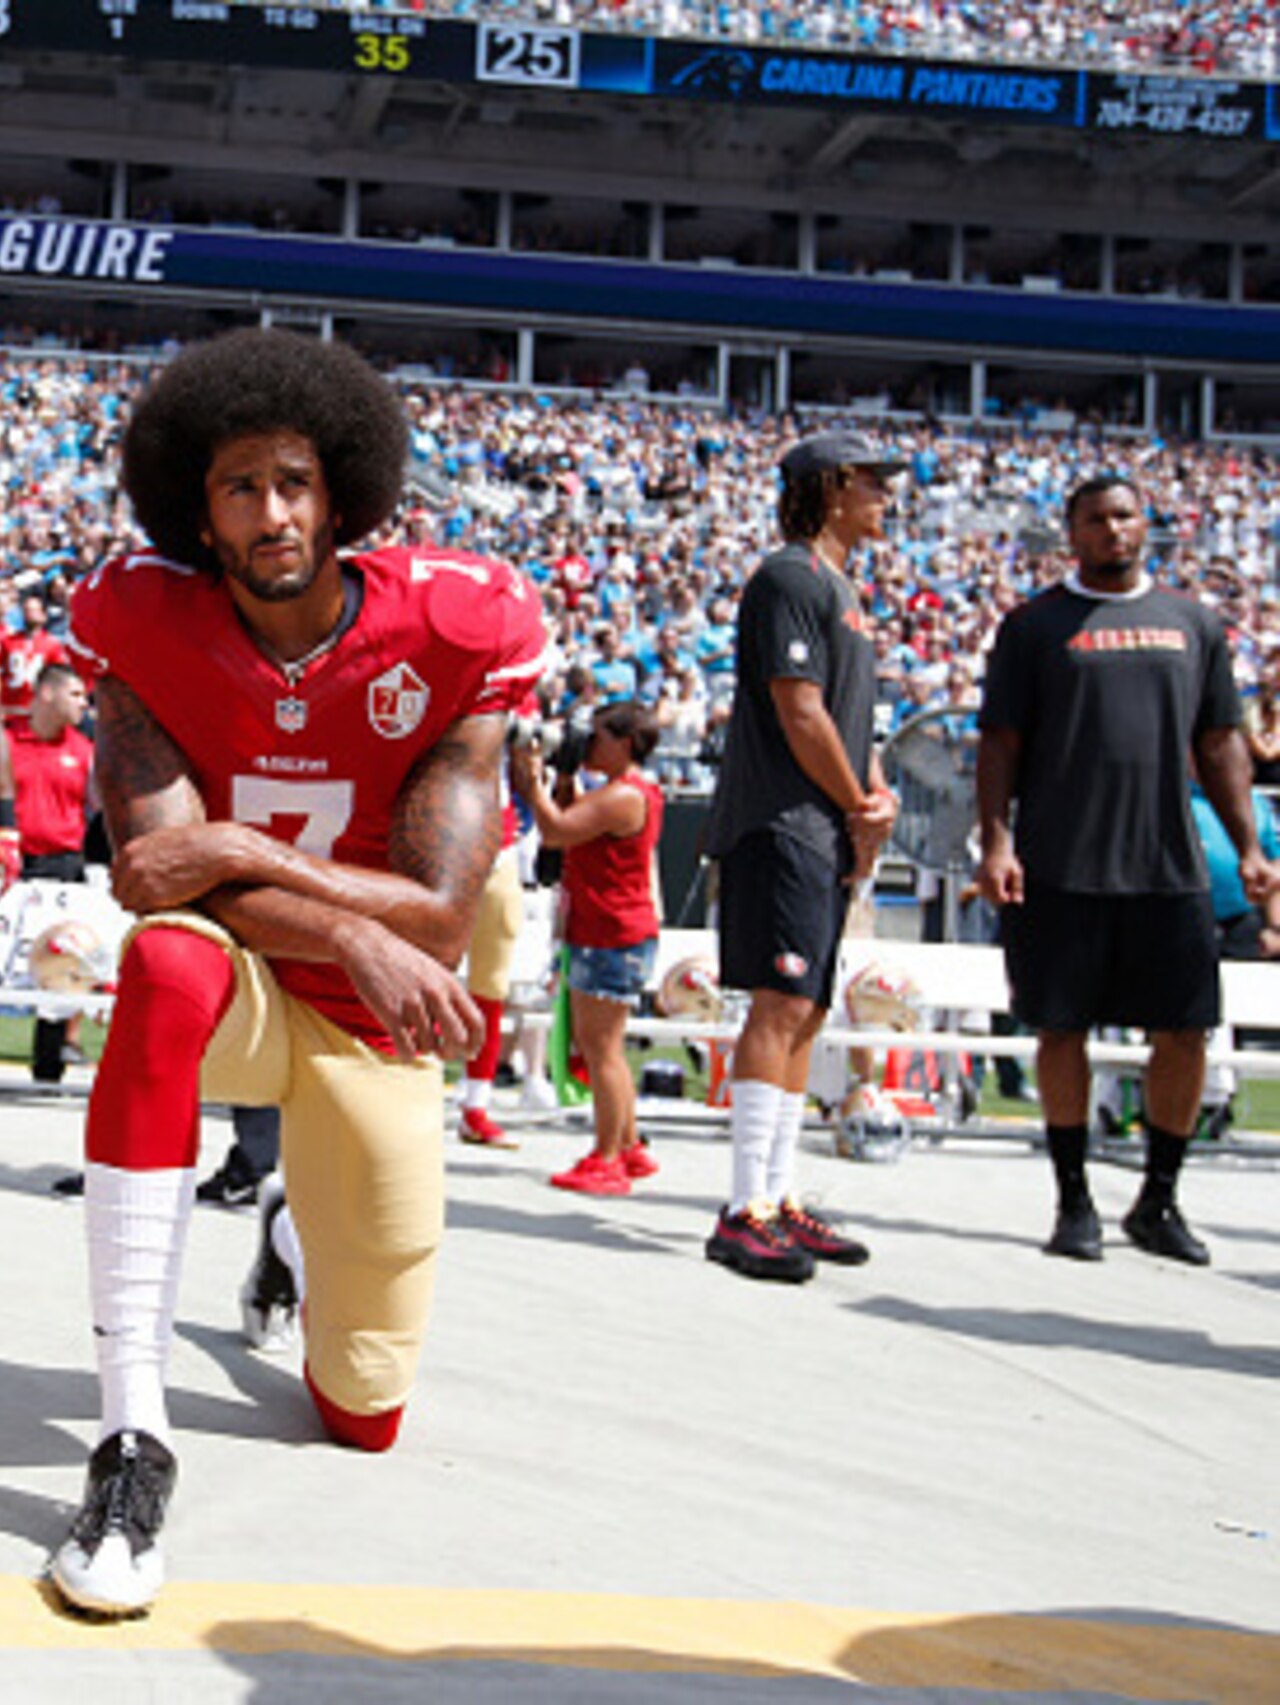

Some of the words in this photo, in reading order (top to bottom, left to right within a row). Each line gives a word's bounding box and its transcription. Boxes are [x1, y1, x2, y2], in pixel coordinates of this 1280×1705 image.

[110, 17, 124, 39] 1
[354, 33, 410, 71] 35
[493, 30, 561, 78] 25
[759, 57, 904, 100] CAROLINA
[909, 69, 1062, 112] PANTHERS
[231, 774, 355, 860] 7
